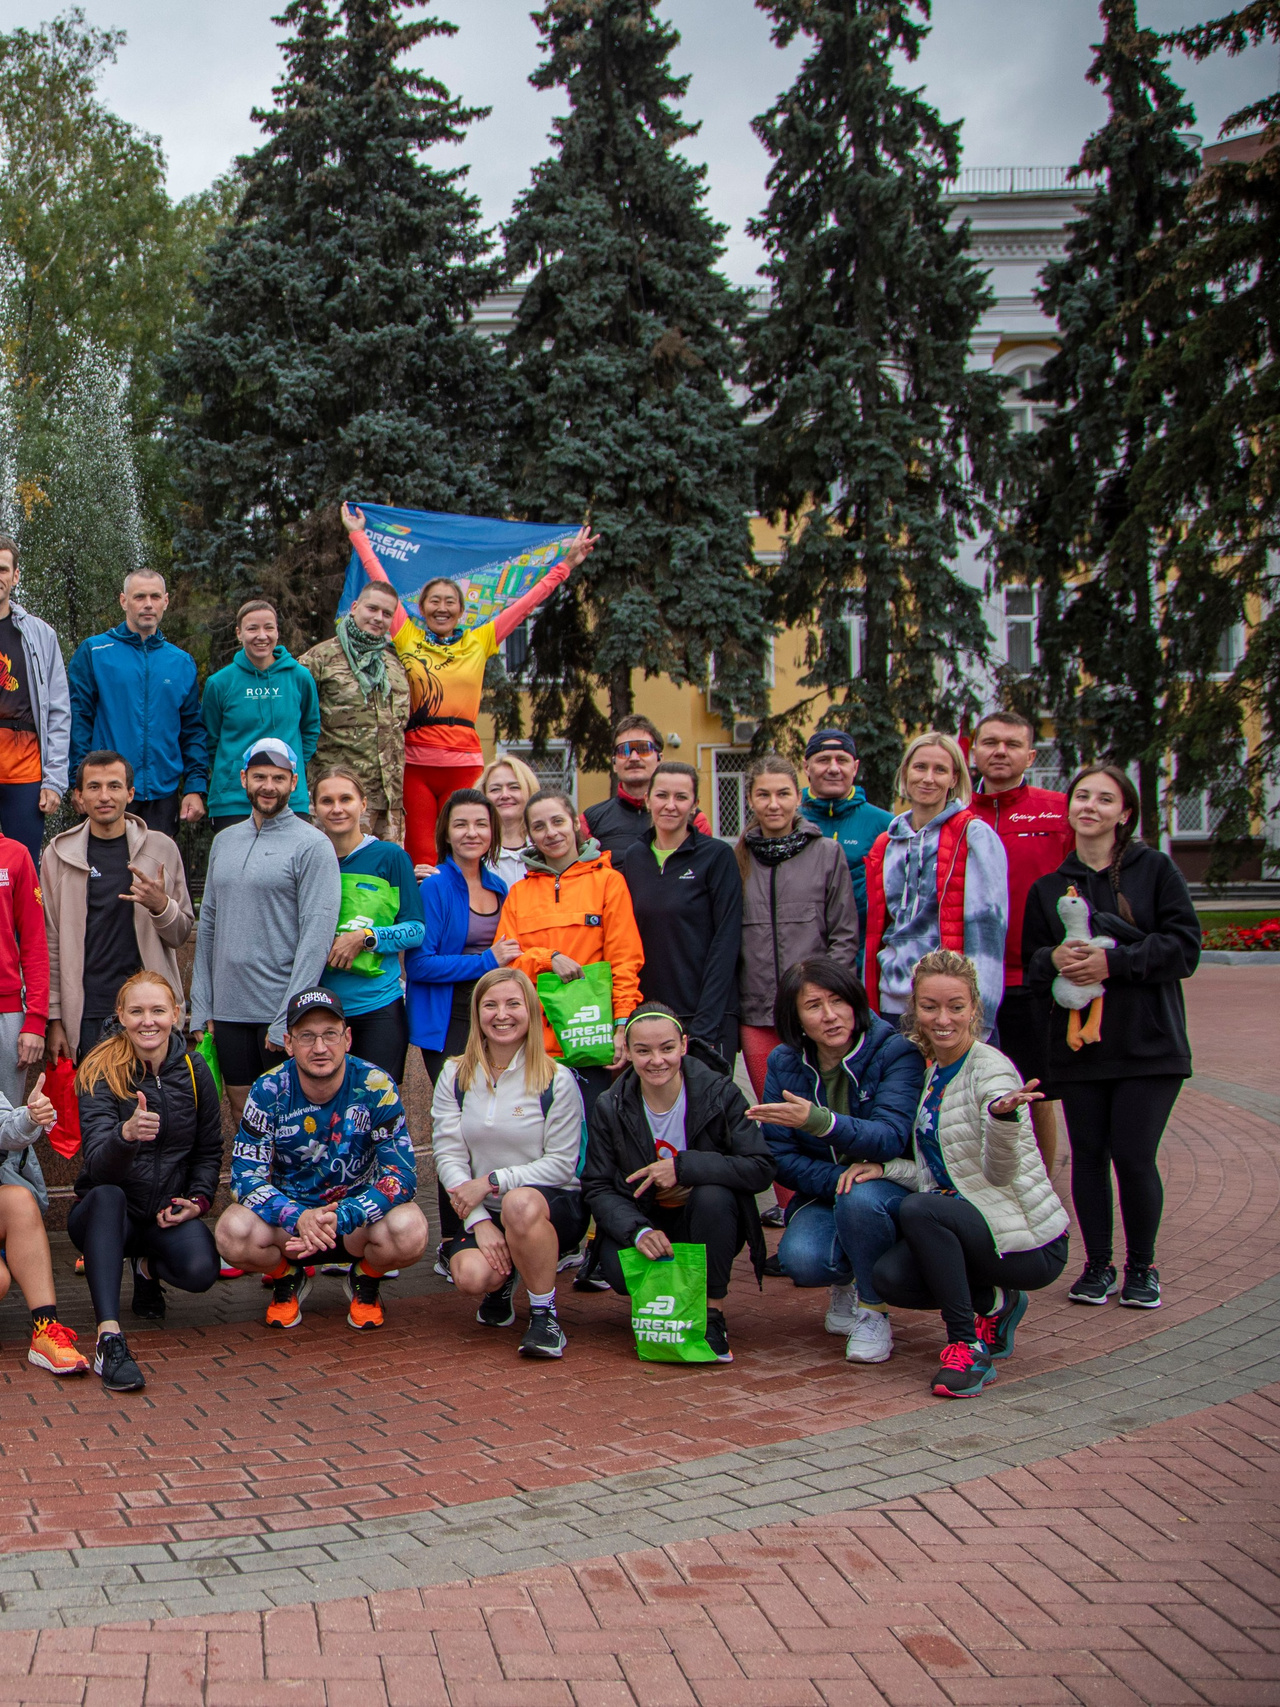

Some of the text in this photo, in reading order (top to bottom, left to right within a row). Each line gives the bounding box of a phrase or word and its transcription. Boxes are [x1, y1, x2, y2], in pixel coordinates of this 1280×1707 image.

[364, 528, 420, 554] DREAM
[369, 541, 409, 562] TRAIL
[246, 687, 280, 696] ROXY
[299, 991, 329, 1002] ГОНКА
[568, 1034, 613, 1048] TRAIL
[631, 1316, 694, 1332] DREAM
[634, 1330, 686, 1344] TRAIL
